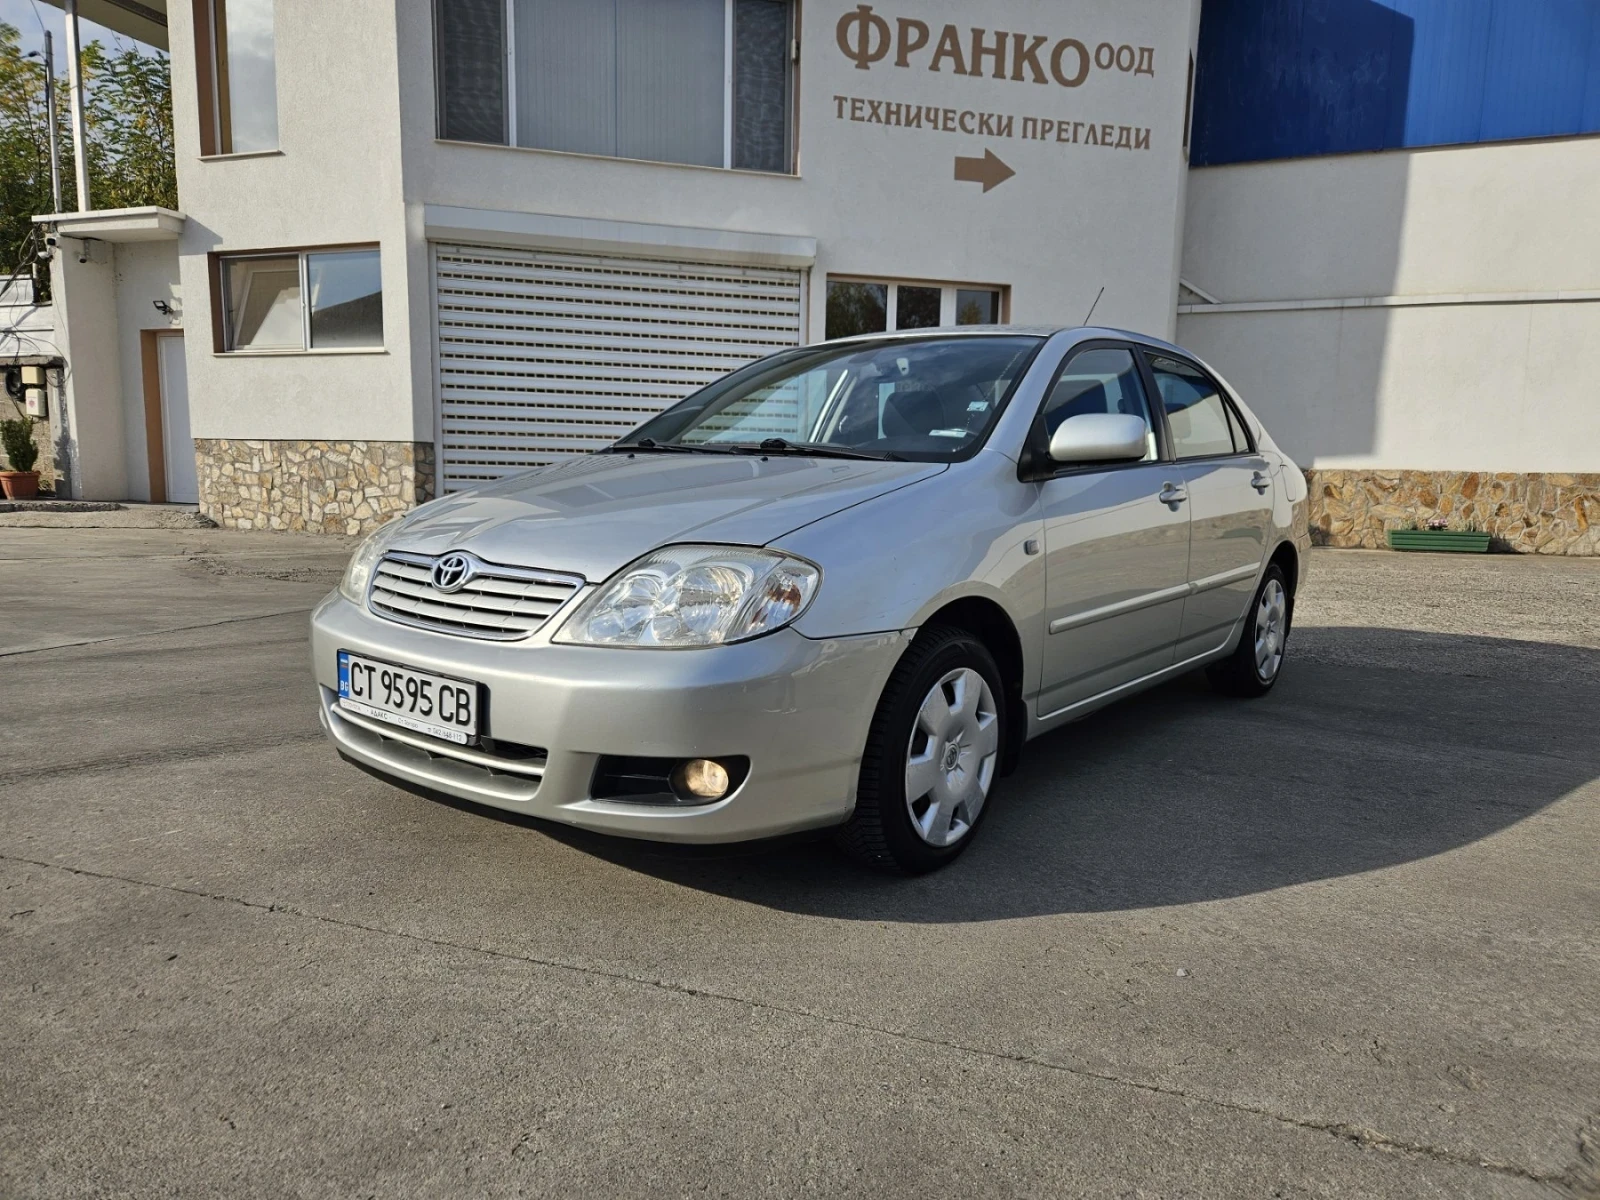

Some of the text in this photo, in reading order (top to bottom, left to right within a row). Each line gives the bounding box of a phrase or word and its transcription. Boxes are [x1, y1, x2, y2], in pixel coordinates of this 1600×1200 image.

[836, 4, 1155, 88] ФРАНКО ООД
[833, 95, 1151, 150] ТЕХНИЧЕСКИ ПРЕГЛЕДИ
[340, 680, 349, 692] BG
[351, 661, 471, 727] CT 9595 CB
